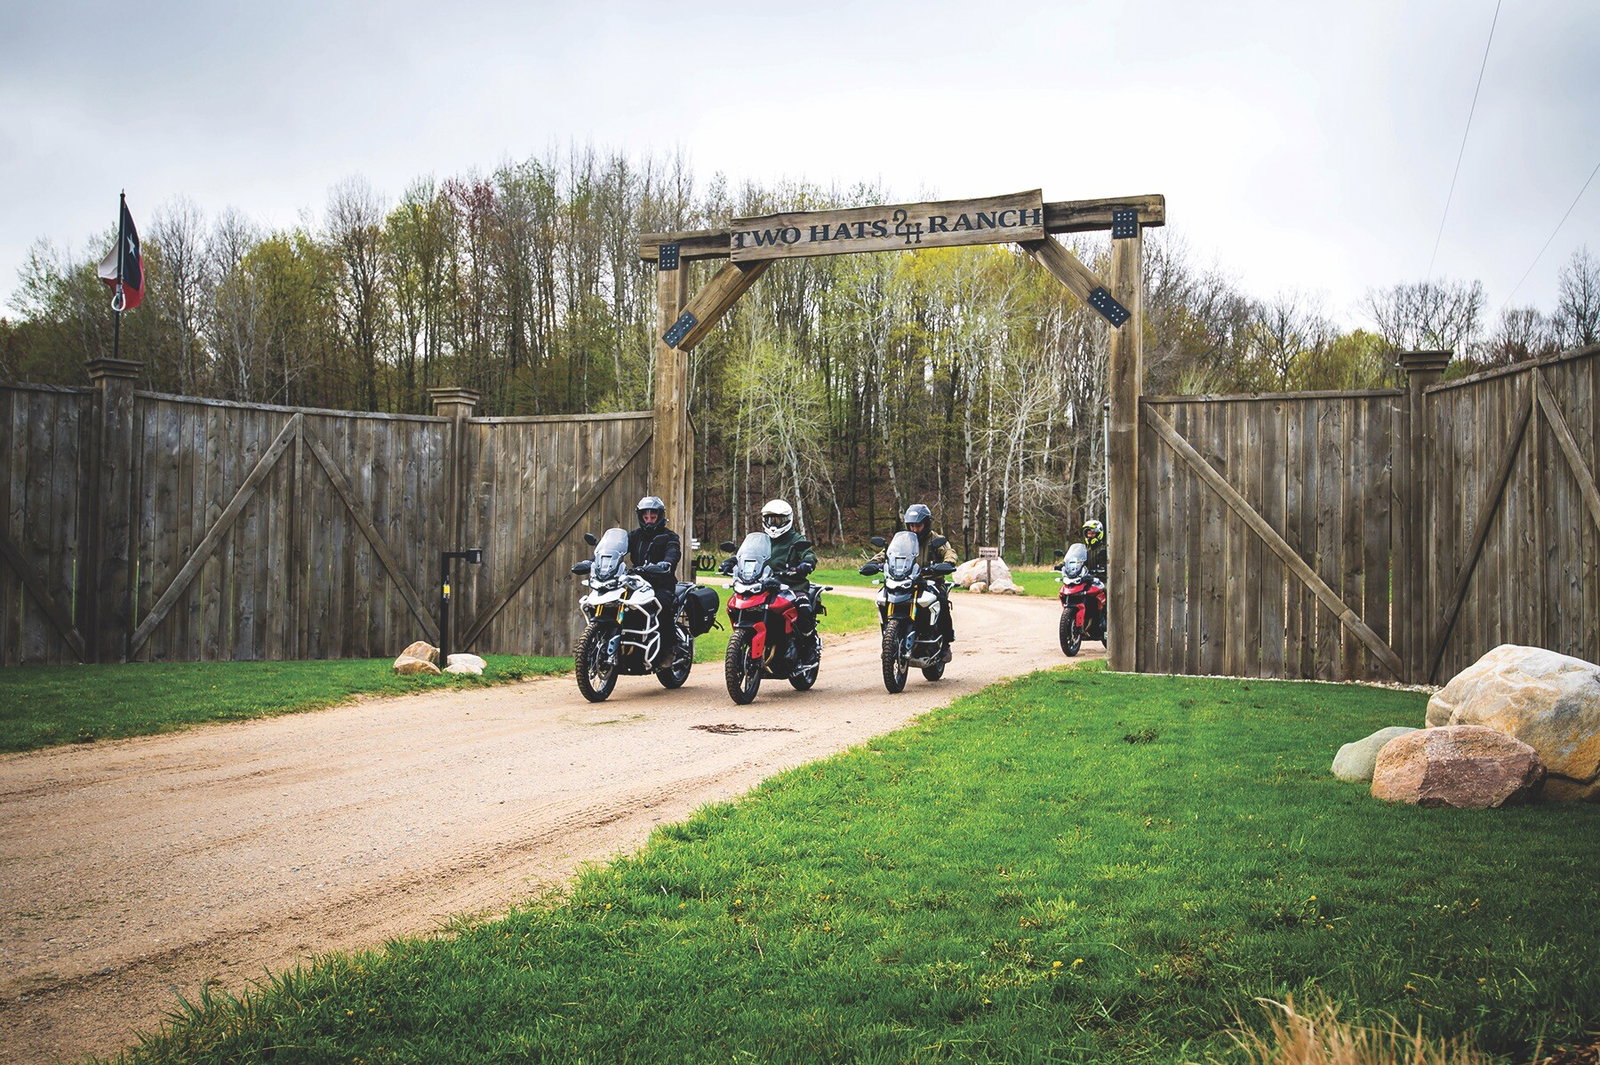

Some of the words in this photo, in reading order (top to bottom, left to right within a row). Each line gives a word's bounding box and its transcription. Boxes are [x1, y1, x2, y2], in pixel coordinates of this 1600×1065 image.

[732, 227, 801, 249] TWO
[809, 219, 888, 242] HATS
[928, 208, 1042, 234] RANCH
